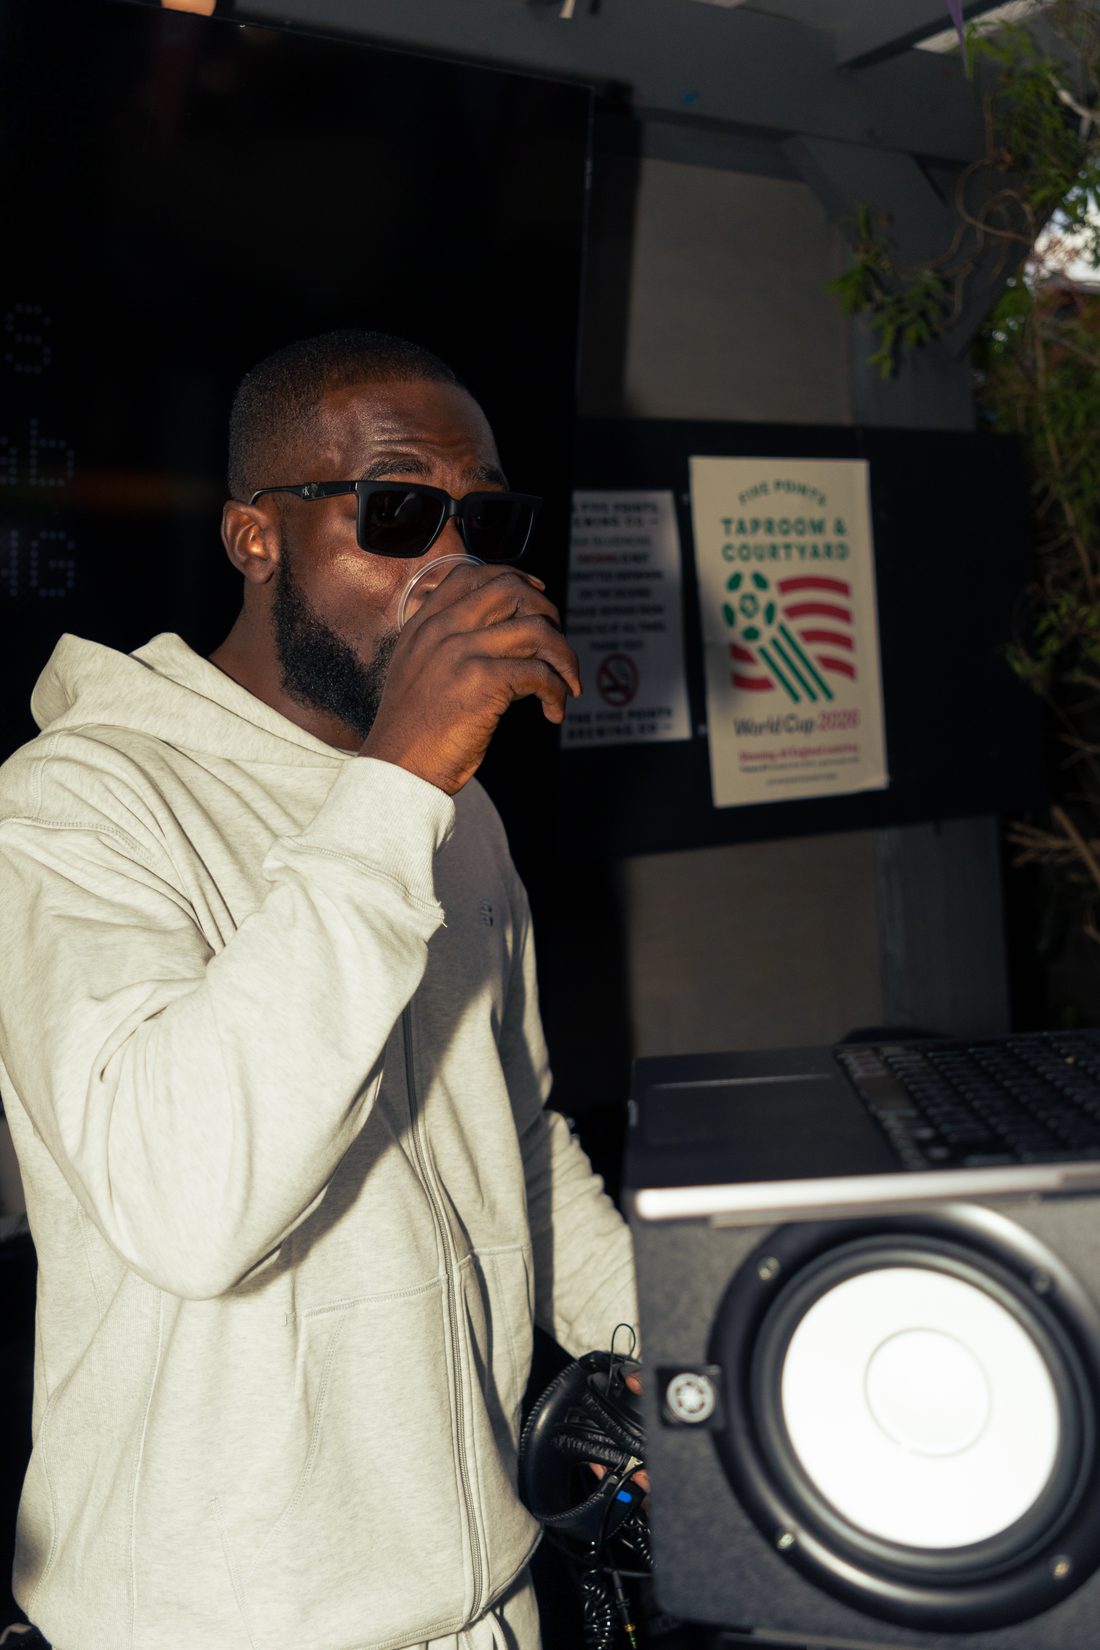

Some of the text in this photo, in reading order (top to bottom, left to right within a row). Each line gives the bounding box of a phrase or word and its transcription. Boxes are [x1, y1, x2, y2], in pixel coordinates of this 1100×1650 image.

[738, 478, 826, 507] FIVE POINTS
[721, 517, 847, 536] TAPROOM &
[721, 543, 849, 562] COURTYARD
[734, 709, 860, 737] World Cup 2026
